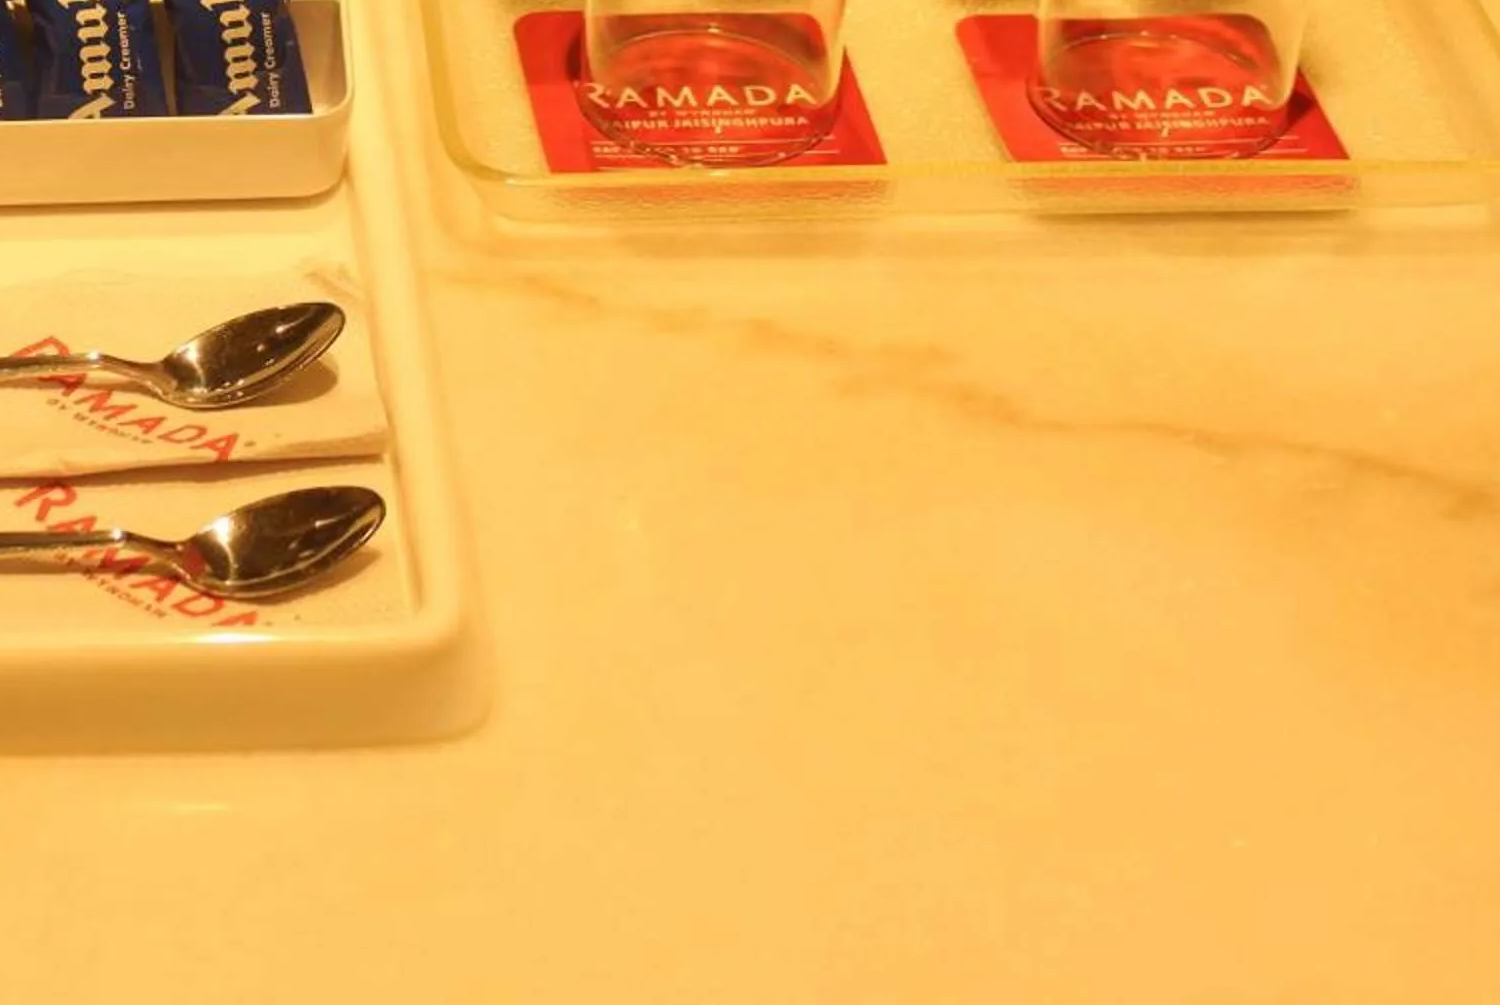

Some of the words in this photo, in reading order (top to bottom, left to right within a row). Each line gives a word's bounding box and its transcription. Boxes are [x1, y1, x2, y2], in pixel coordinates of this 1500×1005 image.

[116, 11, 132, 71] Creamer
[261, 12, 276, 69] Creamer
[119, 74, 136, 110] Dairy
[266, 71, 282, 108] Dairy
